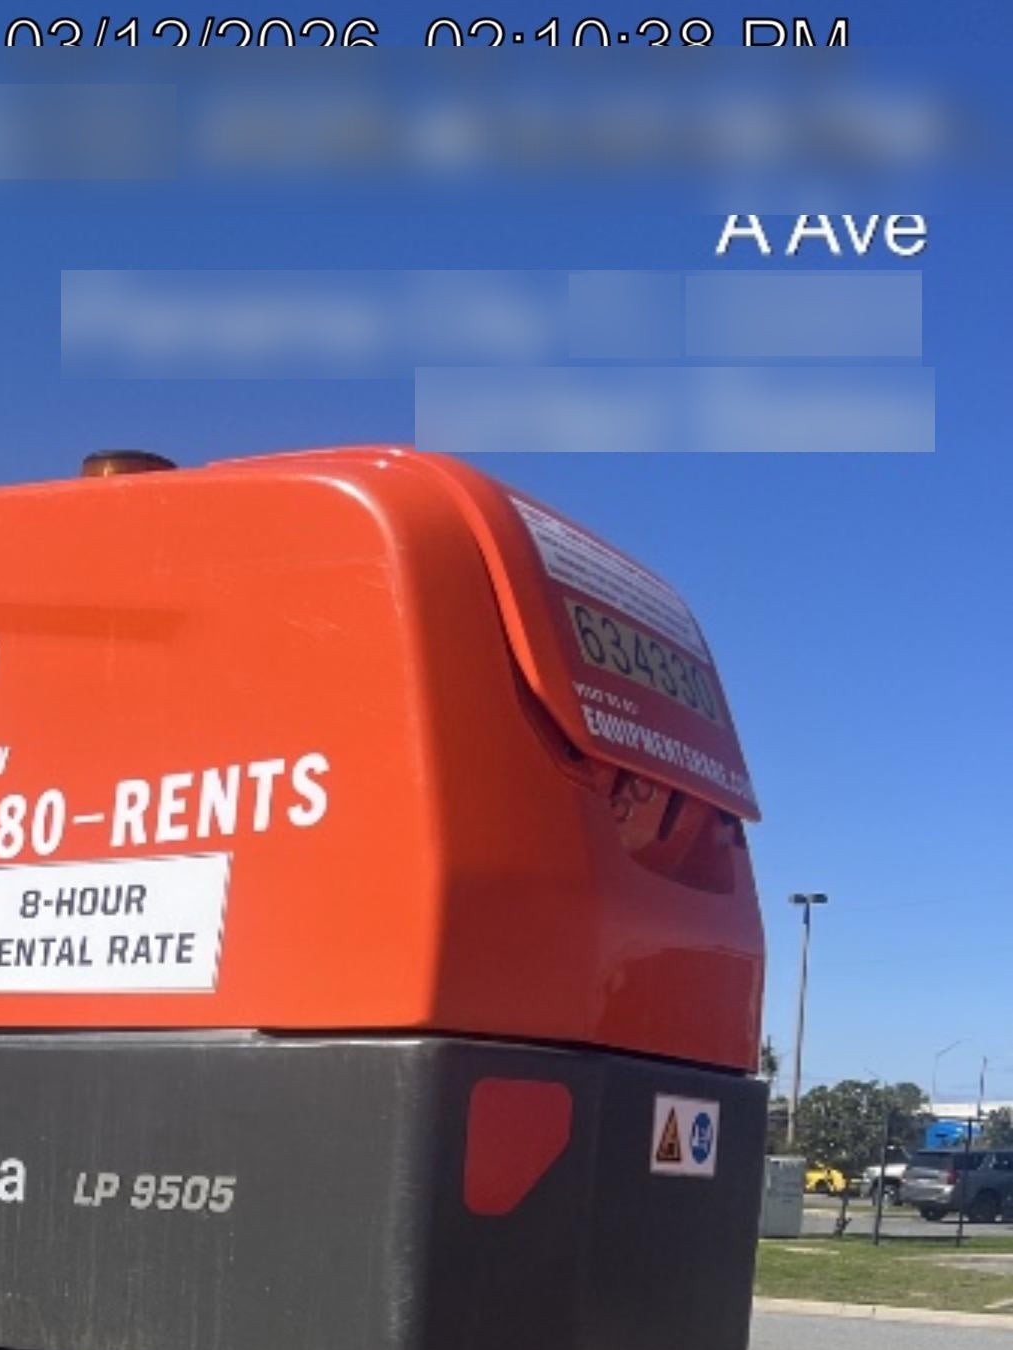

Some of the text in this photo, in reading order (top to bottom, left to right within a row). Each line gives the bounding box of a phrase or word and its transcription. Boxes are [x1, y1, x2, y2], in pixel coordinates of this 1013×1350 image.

[574, 603, 718, 722] 634330
[19, 884, 148, 920] 8-HOUR
[107, 931, 195, 965] RATE
[73, 1172, 237, 1213] LP 9505
